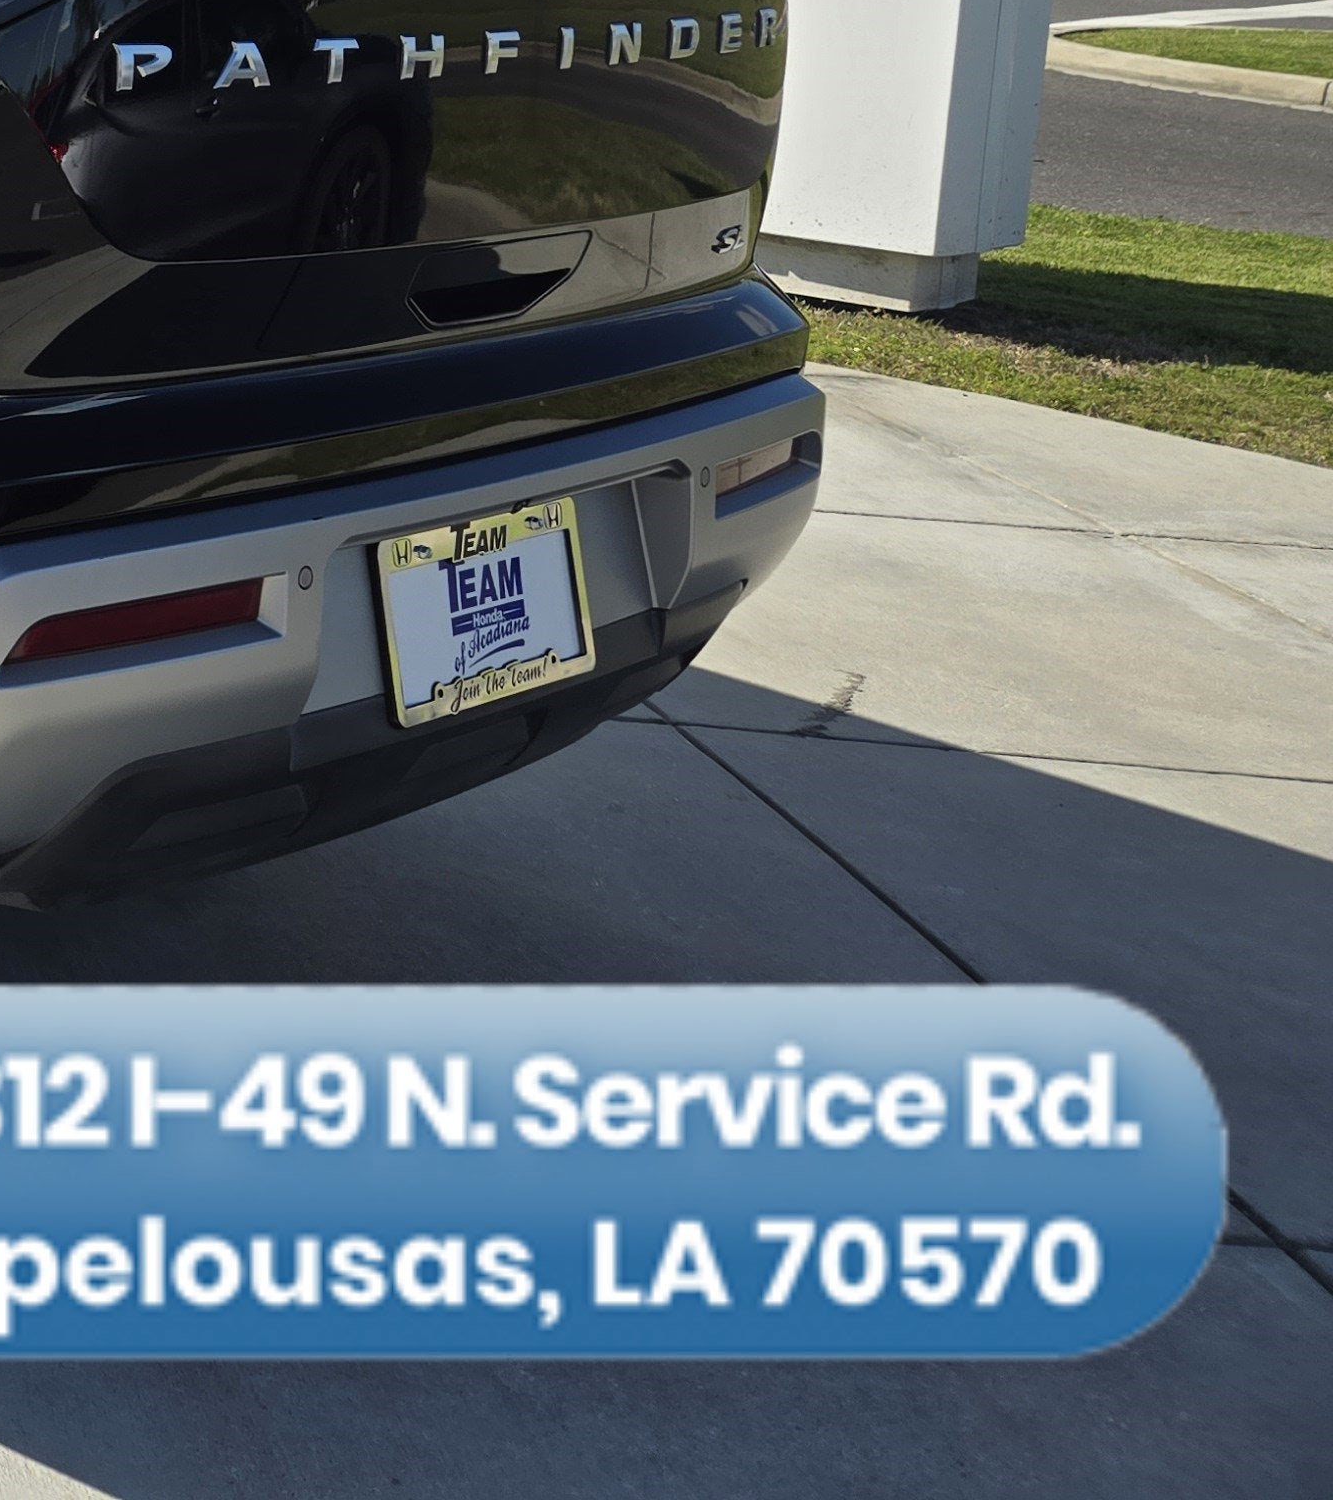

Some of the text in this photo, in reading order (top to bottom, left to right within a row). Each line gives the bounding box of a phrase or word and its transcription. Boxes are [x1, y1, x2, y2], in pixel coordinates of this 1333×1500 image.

[115, 6, 779, 92] PATHFINDER
[450, 521, 507, 561] TEAM
[438, 556, 524, 613] TEAM
[455, 615, 531, 675] of Acadiana
[473, 607, 504, 629] Honda
[451, 657, 548, 713] Join The Team!
